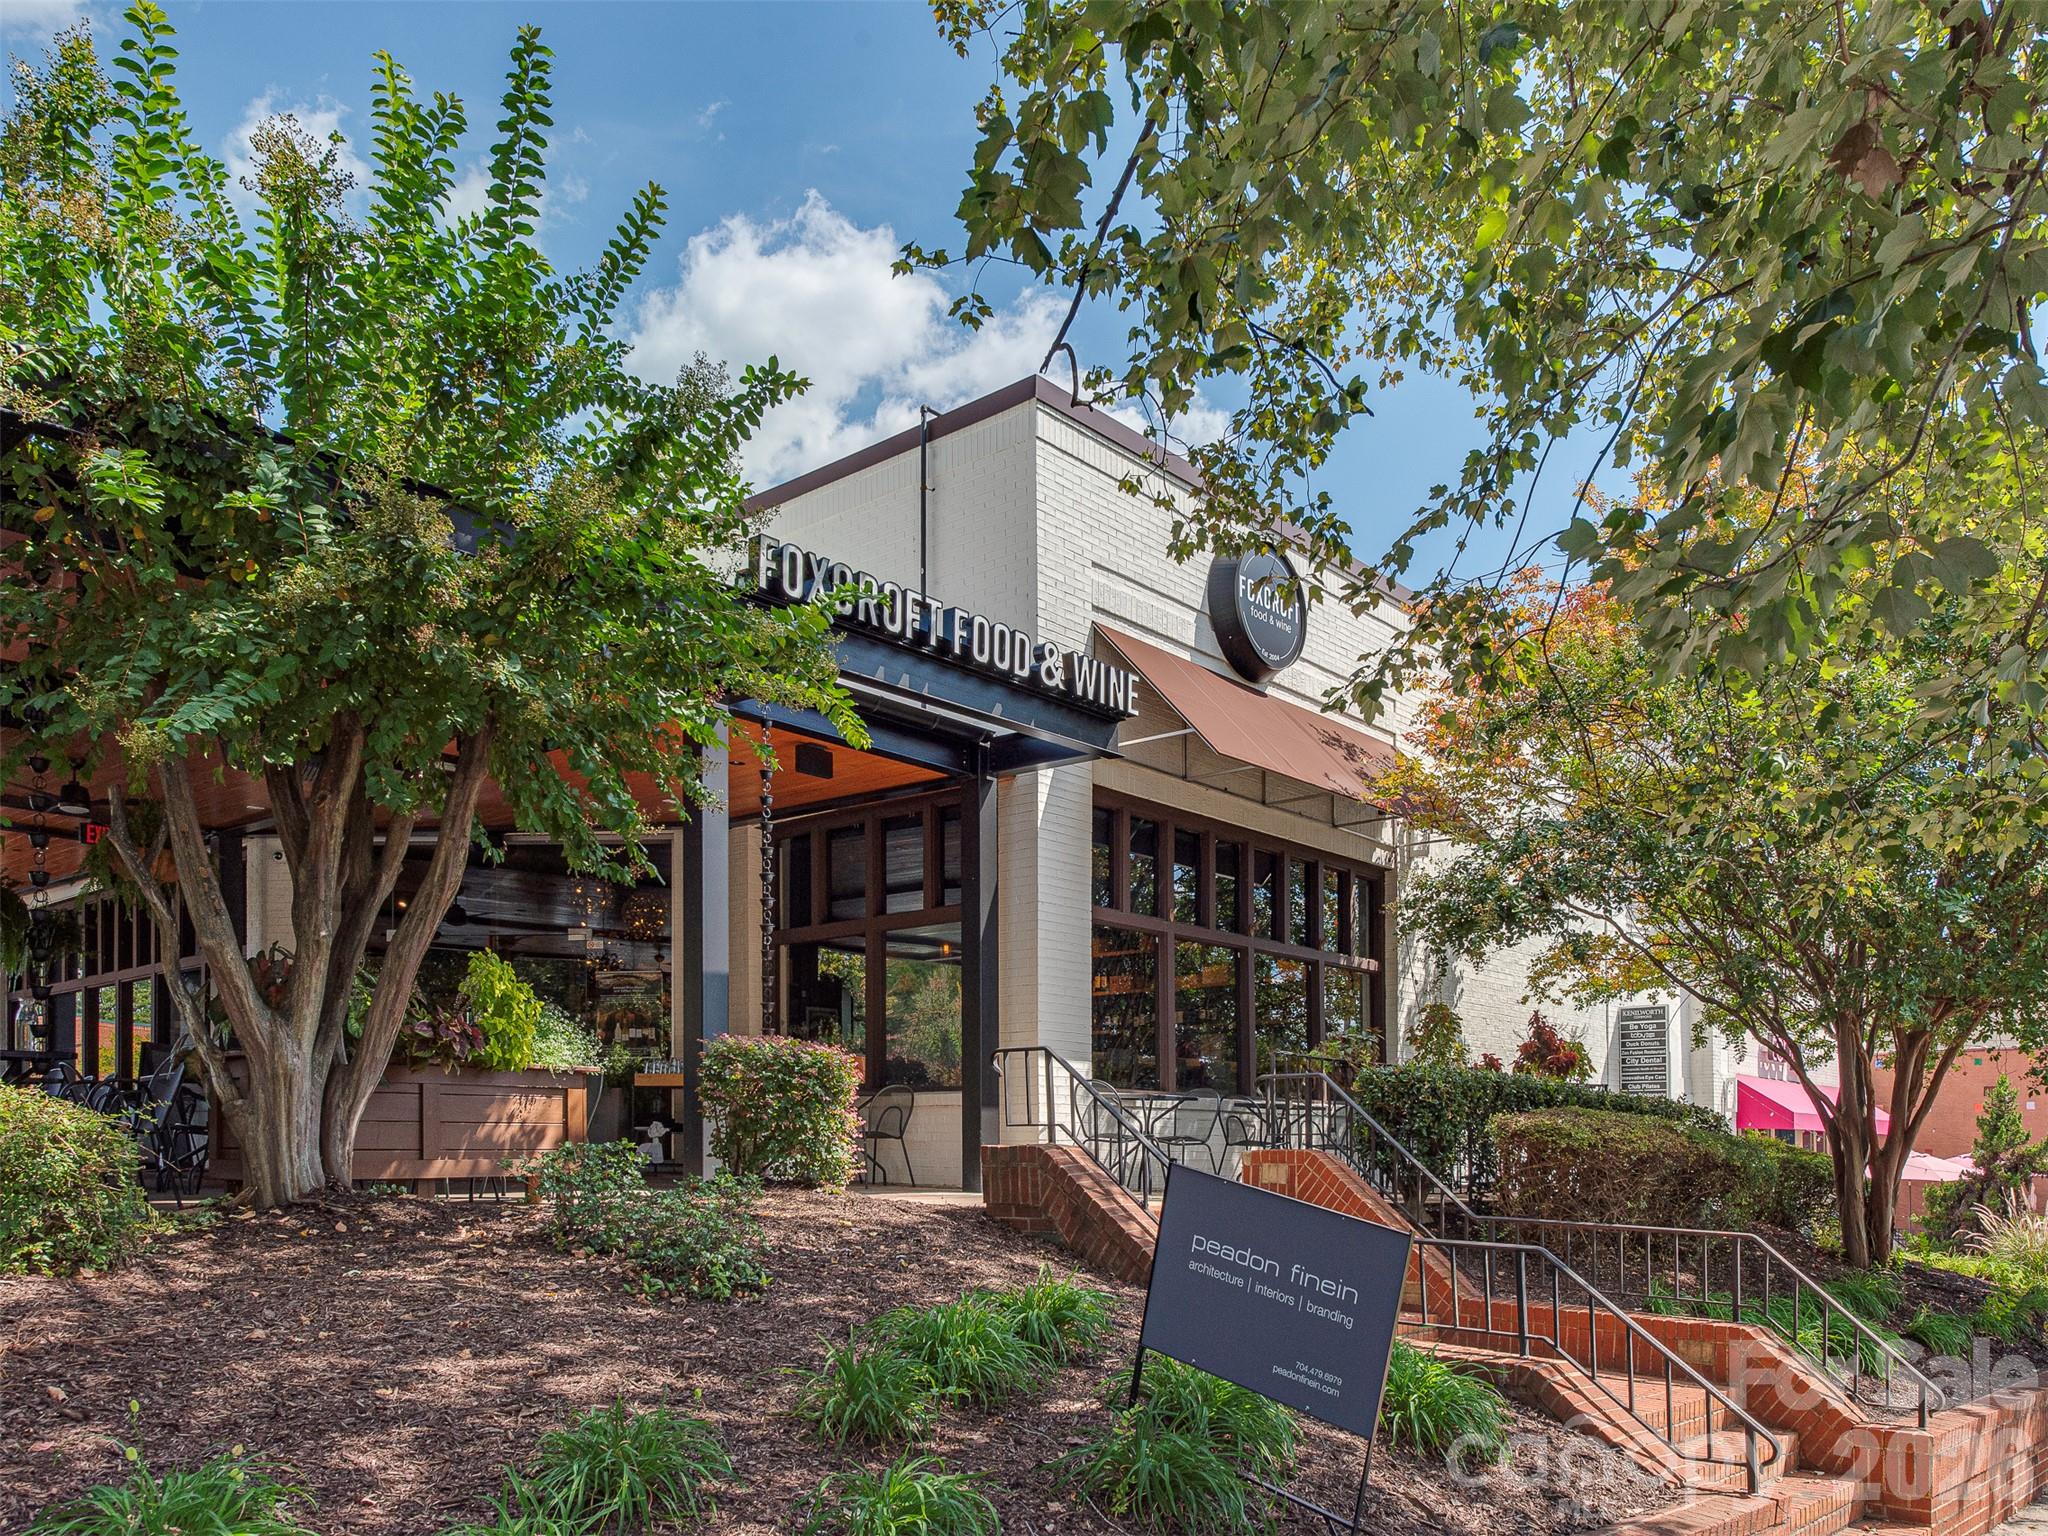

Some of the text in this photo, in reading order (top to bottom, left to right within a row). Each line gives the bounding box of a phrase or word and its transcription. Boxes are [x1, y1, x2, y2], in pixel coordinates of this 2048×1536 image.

[754, 534, 1139, 716] FOXCROFT FOOD & WINE
[1250, 605, 1268, 622] food
[1276, 618, 1292, 634] wine
[1622, 1008, 1664, 1016] KENILWORTH
[1625, 1056, 1662, 1065] City Dental
[1191, 1234, 1359, 1305] peadon finein
[1188, 1259, 1244, 1287] architecture
[1254, 1281, 1295, 1306] interiors
[1306, 1300, 1354, 1330] branding
[1272, 1365, 1340, 1398] peadonfinein.com
